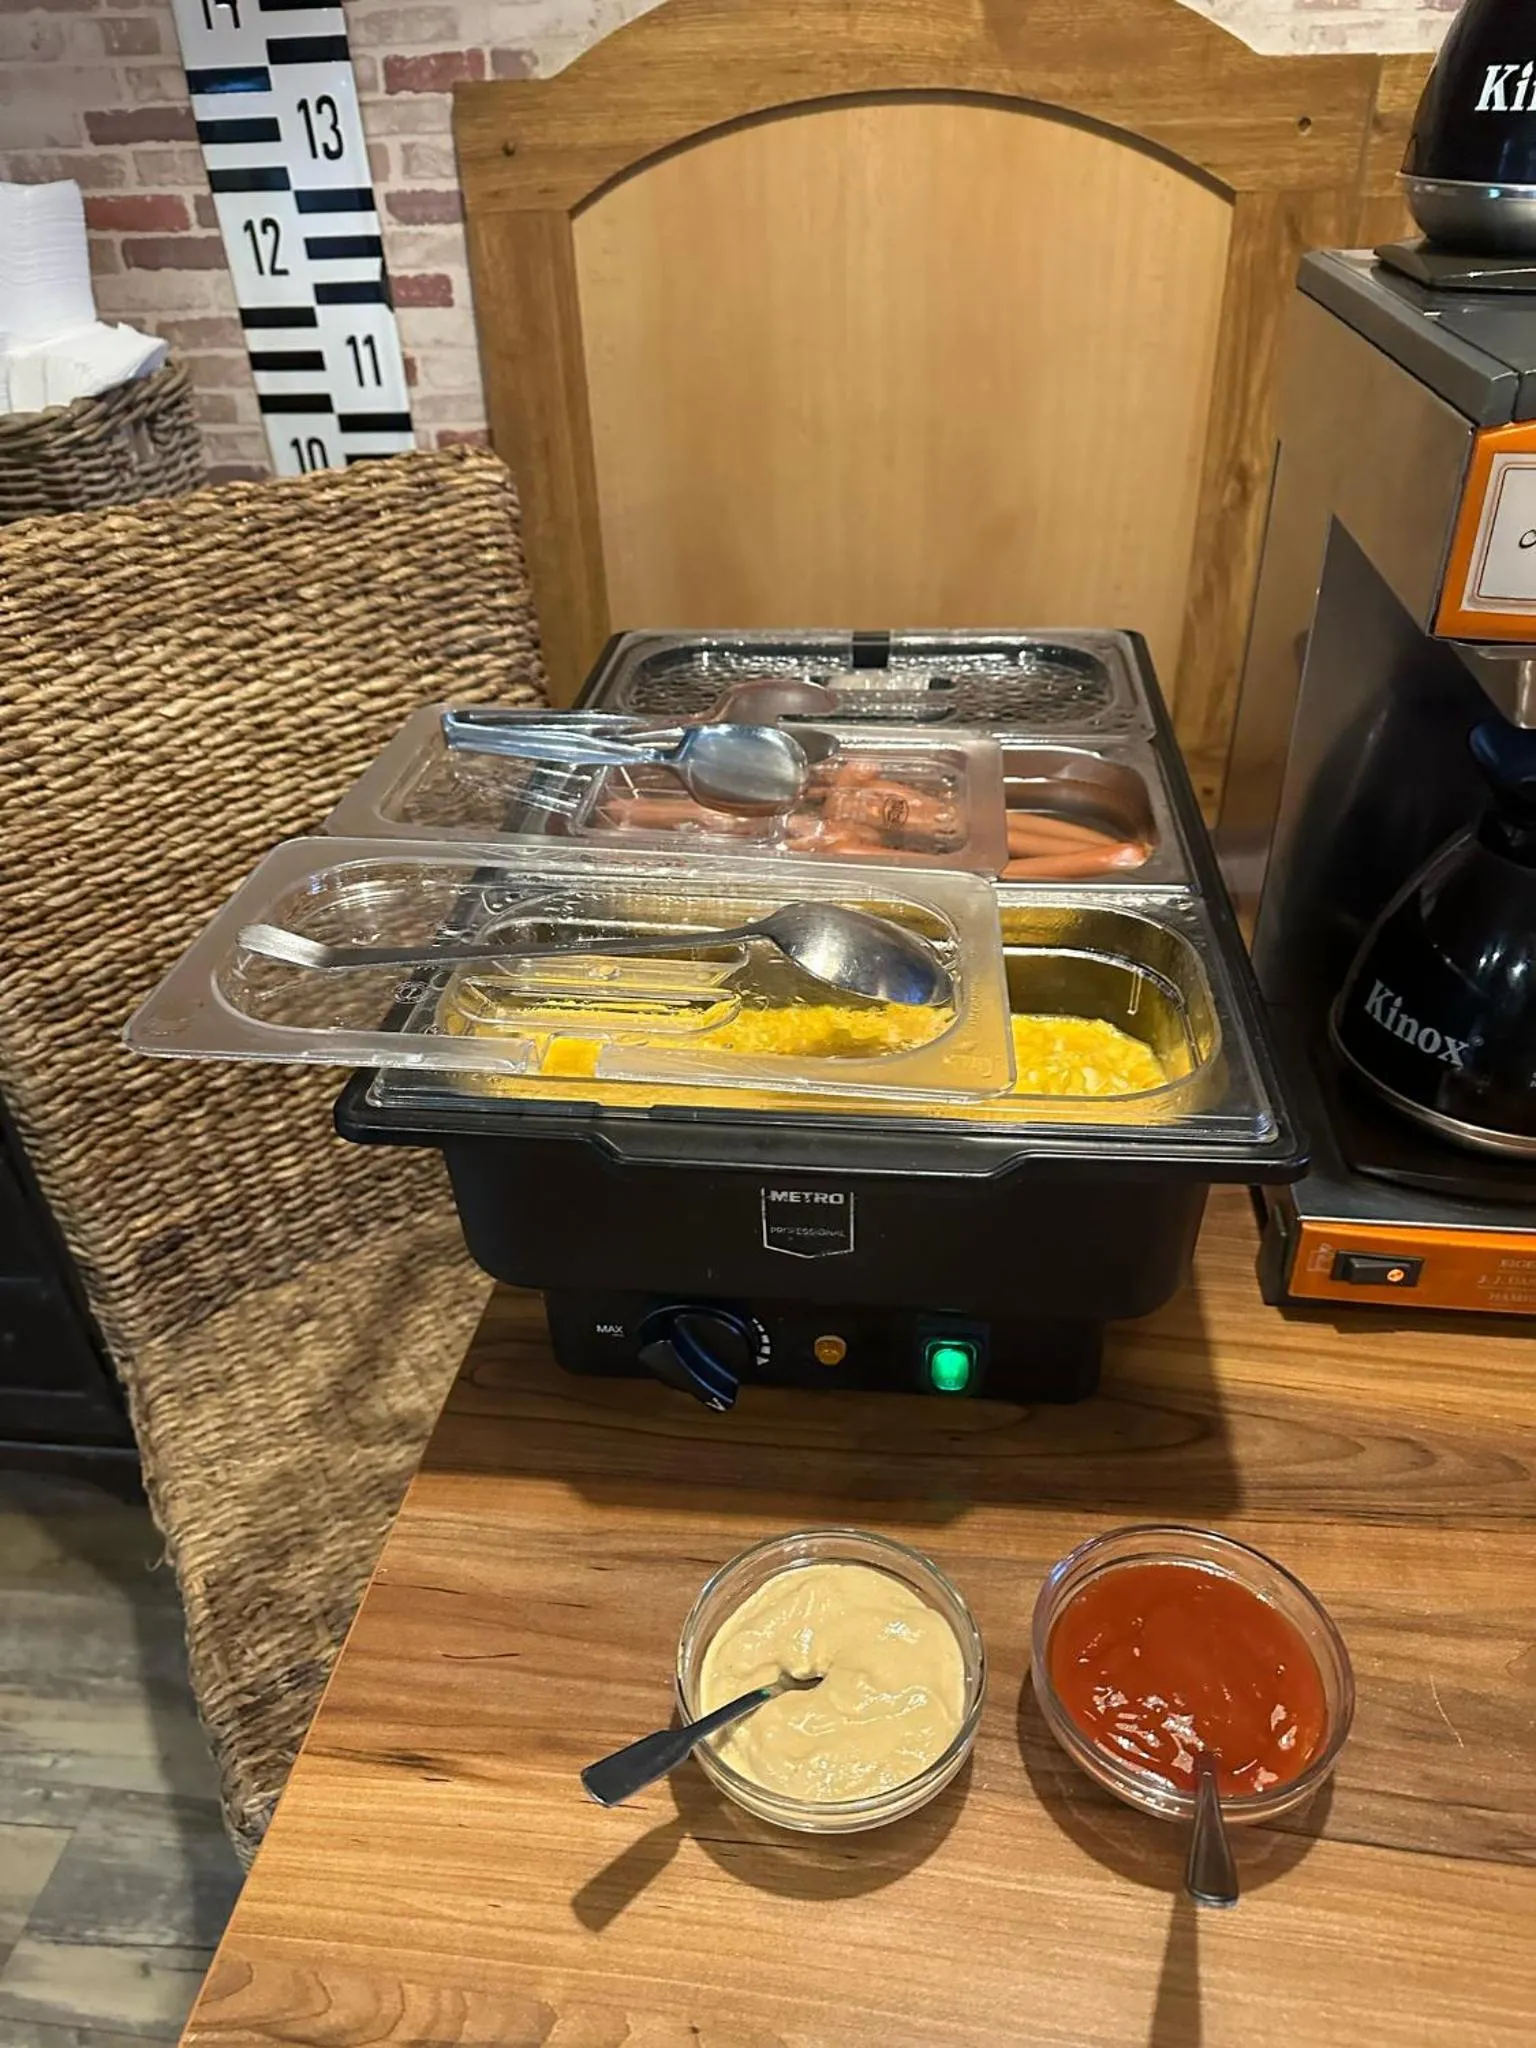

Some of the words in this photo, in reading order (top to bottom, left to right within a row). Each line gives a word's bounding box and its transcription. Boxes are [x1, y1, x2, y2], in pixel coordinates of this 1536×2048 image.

[297, 94, 344, 161] 13
[243, 217, 290, 276] 12
[345, 334, 382, 388] 11
[1364, 978, 1470, 1069] Kinox
[769, 1190, 845, 1205] METRO
[595, 1323, 625, 1334] MAX
